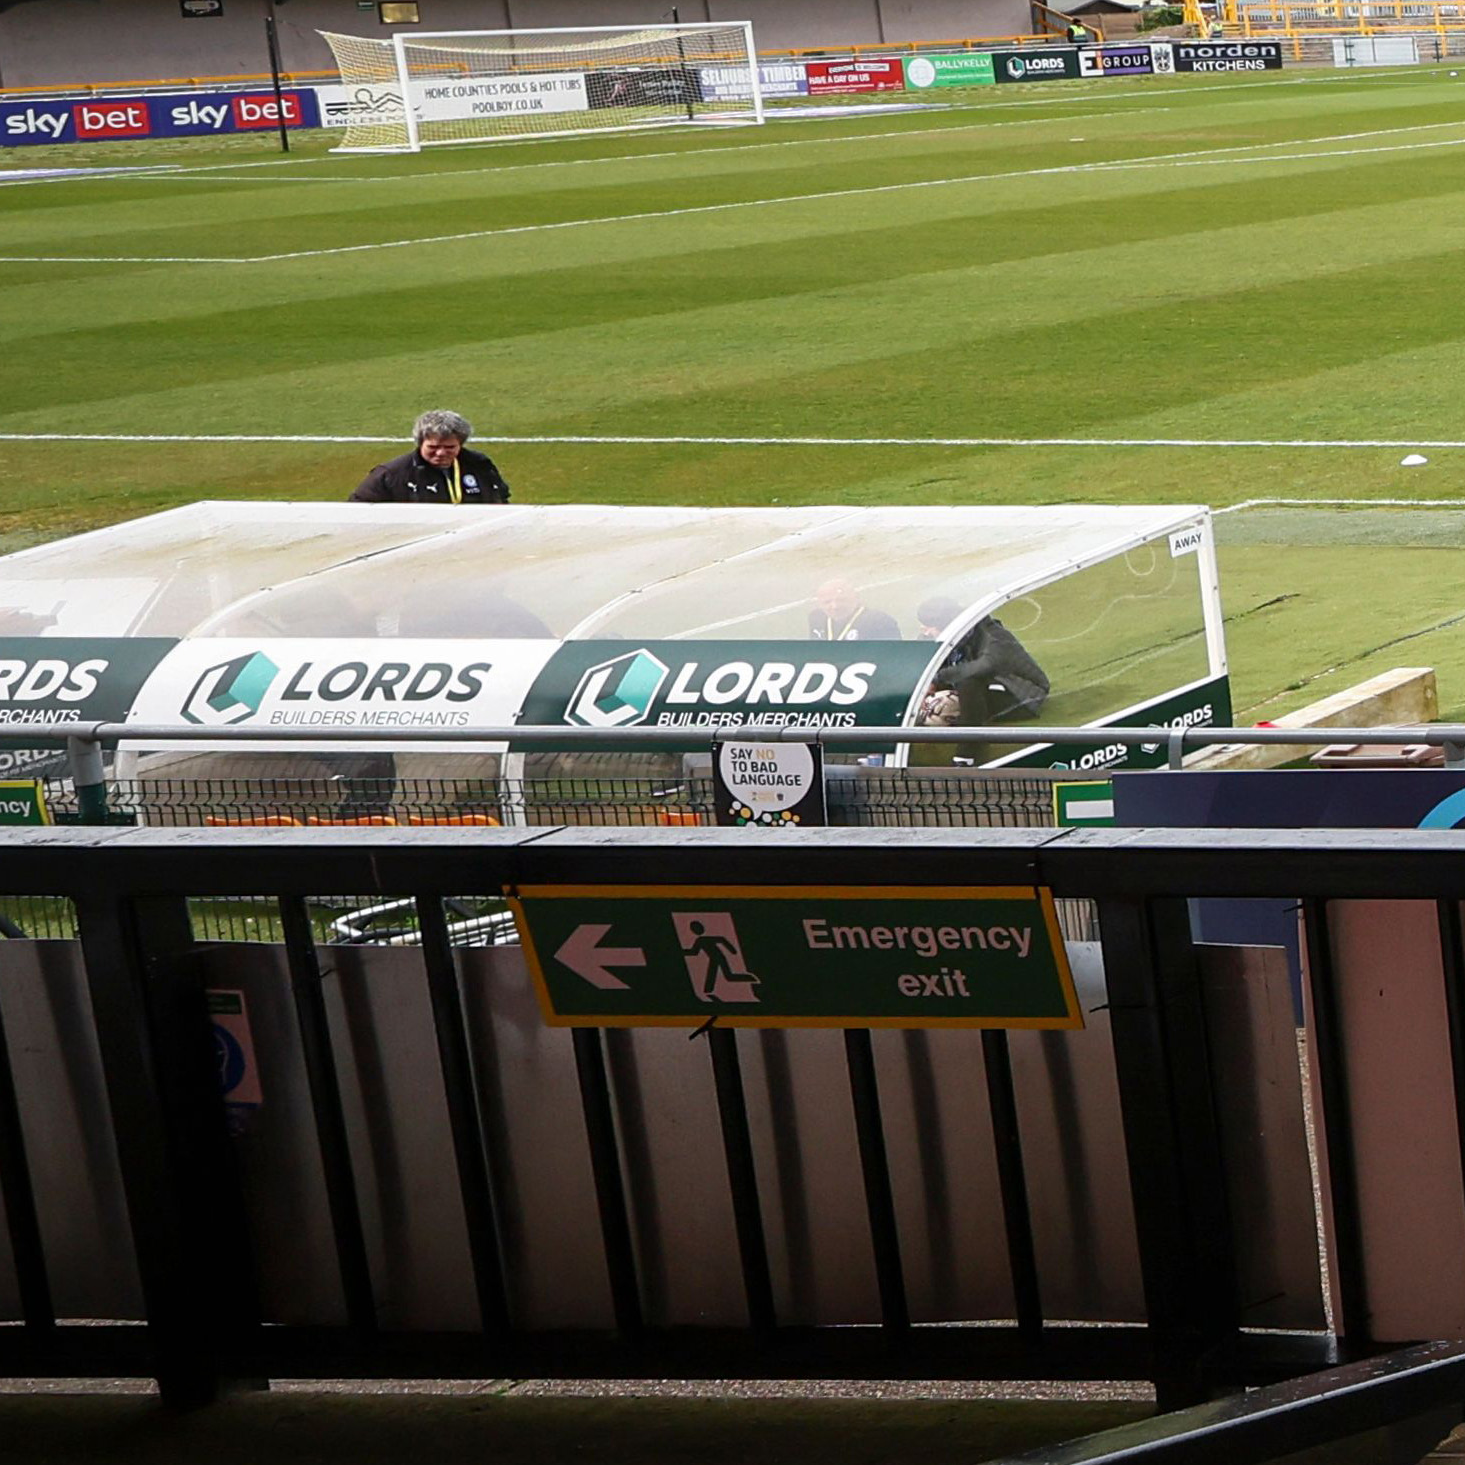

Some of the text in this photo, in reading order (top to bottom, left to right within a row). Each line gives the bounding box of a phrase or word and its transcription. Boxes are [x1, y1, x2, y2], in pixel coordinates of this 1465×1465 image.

[1180, 44, 1276, 58] norden
[934, 59, 991, 70] BALLYKELLY
[1025, 57, 1065, 71] LORDS
[1103, 55, 1150, 67] GROUP
[1192, 60, 1265, 72] KITCHENS
[702, 66, 806, 85] SELHURS TIMBER
[809, 76, 828, 84] HAVE
[425, 86, 451, 99] HOME
[452, 82, 499, 97] COUNTIES
[500, 81, 528, 95] POOLS
[539, 80, 558, 92] HOT
[559, 78, 582, 91] TUBS
[171, 98, 295, 129] sky bet
[472, 98, 543, 114] POOLBOY.CO.UK
[5, 106, 143, 138] sky bet
[1173, 533, 1203, 551] AWAY
[280, 661, 492, 702] LORDS
[666, 661, 877, 704] LORDS
[270, 710, 470, 725] BUILDERS MERCHANTS
[657, 712, 856, 727] BUILDERS MERCHANTS
[1163, 704, 1213, 729] LORDS
[730, 748, 775, 760] SAY NO
[1071, 743, 1128, 770] LORDS
[732, 761, 778, 773] TO BAD
[732, 774, 802, 786] LANGUAGE
[802, 919, 1032, 958] Emergency
[897, 967, 970, 998] exit
